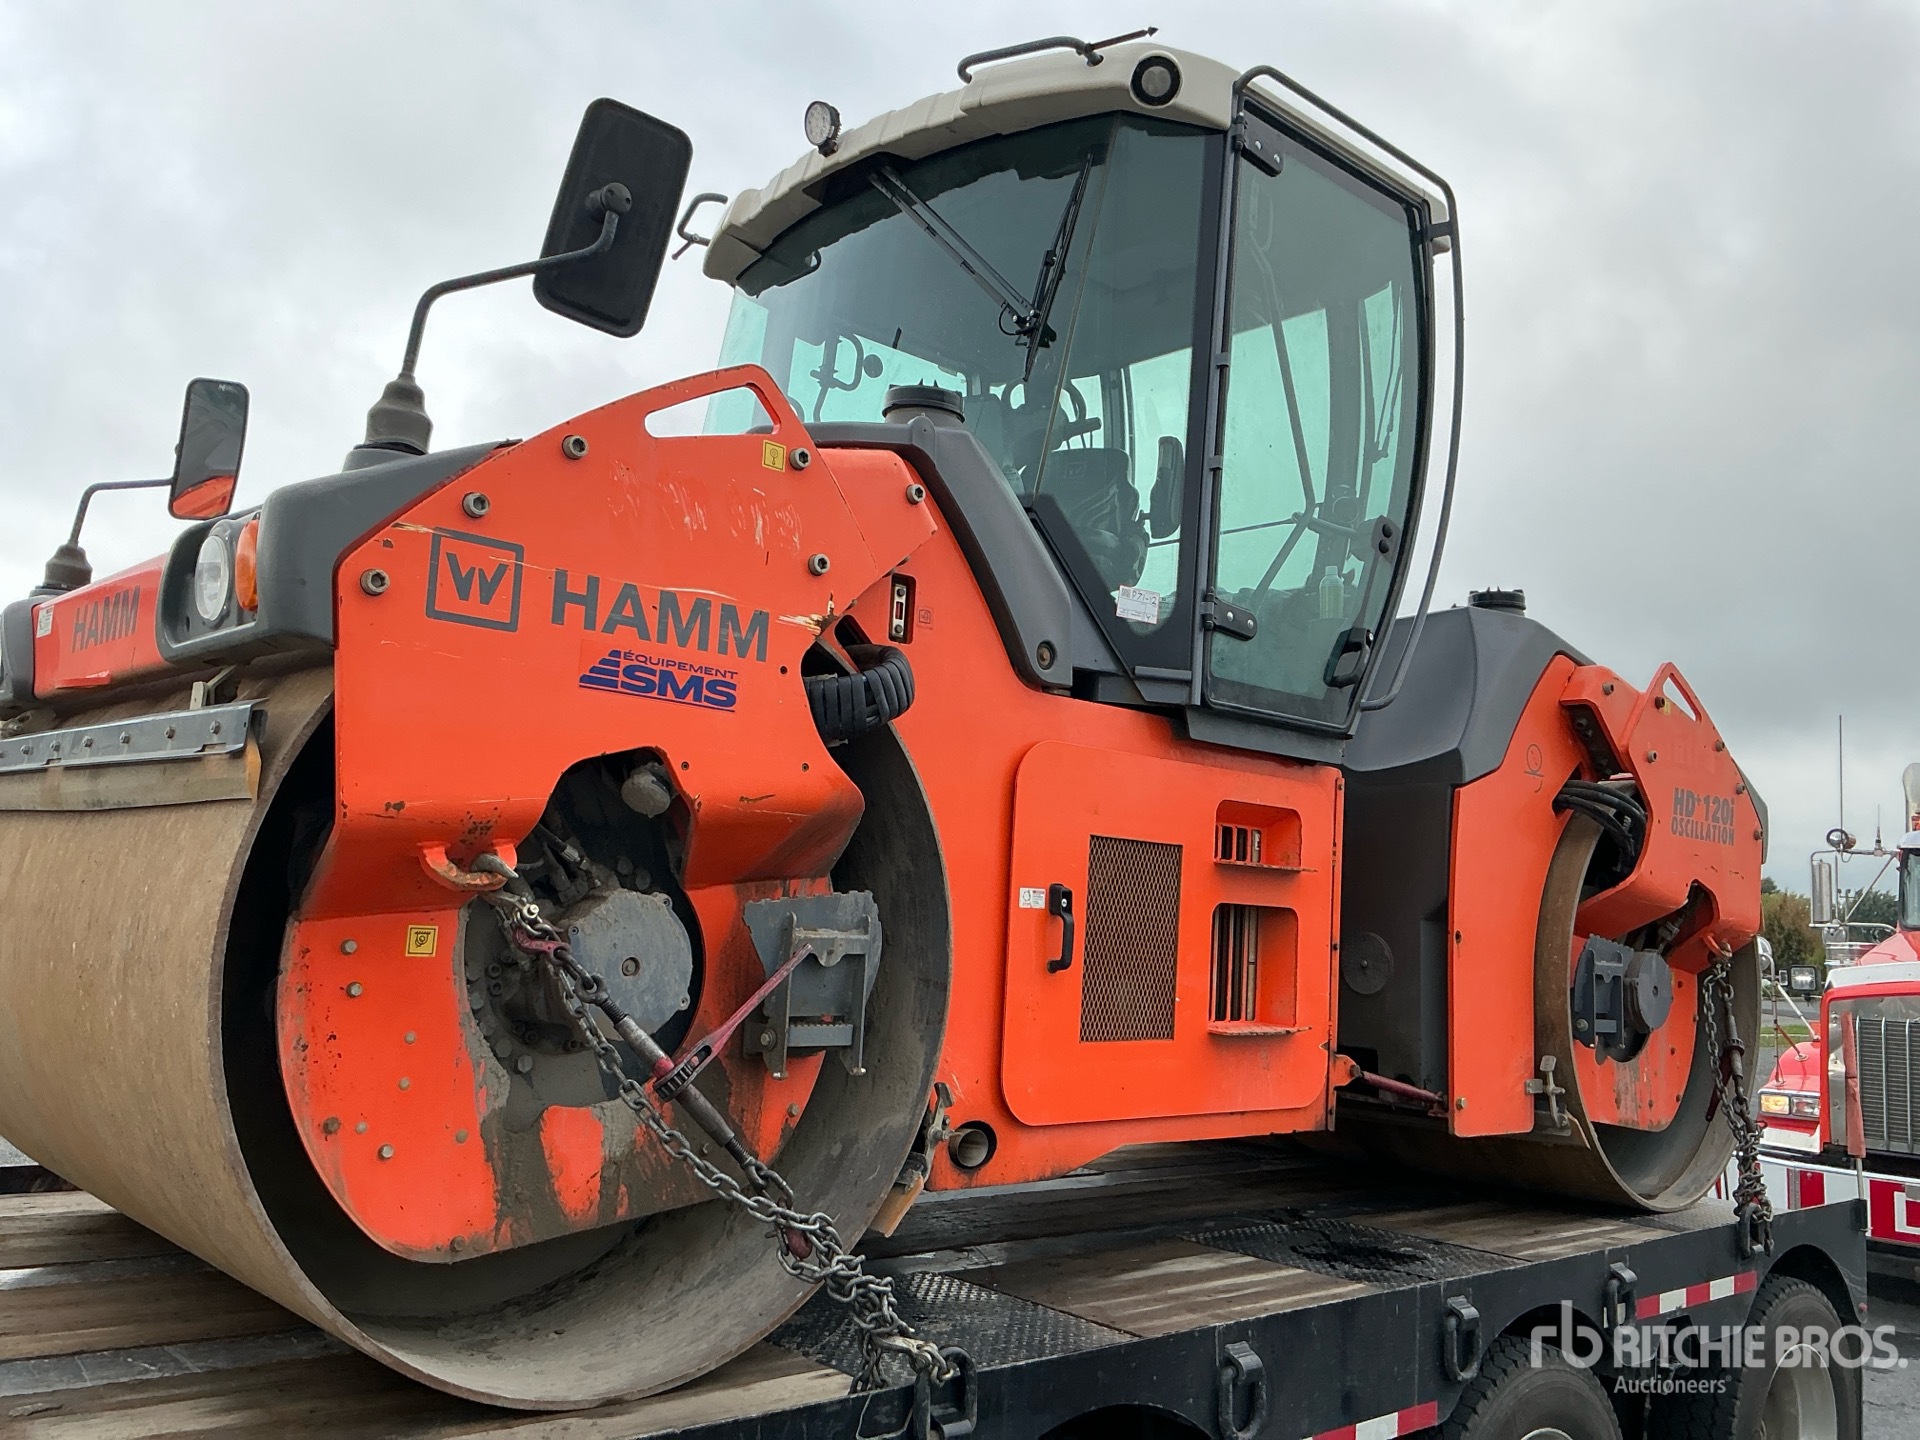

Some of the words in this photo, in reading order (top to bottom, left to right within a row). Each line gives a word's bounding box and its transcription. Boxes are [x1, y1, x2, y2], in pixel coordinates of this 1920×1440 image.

[71, 585, 141, 654] HAMM
[551, 568, 770, 663] HAMM
[620, 664, 737, 708] SMS
[623, 650, 738, 680] ÉQUIPEMENT
[1671, 816, 1735, 846] OSCILLATION
